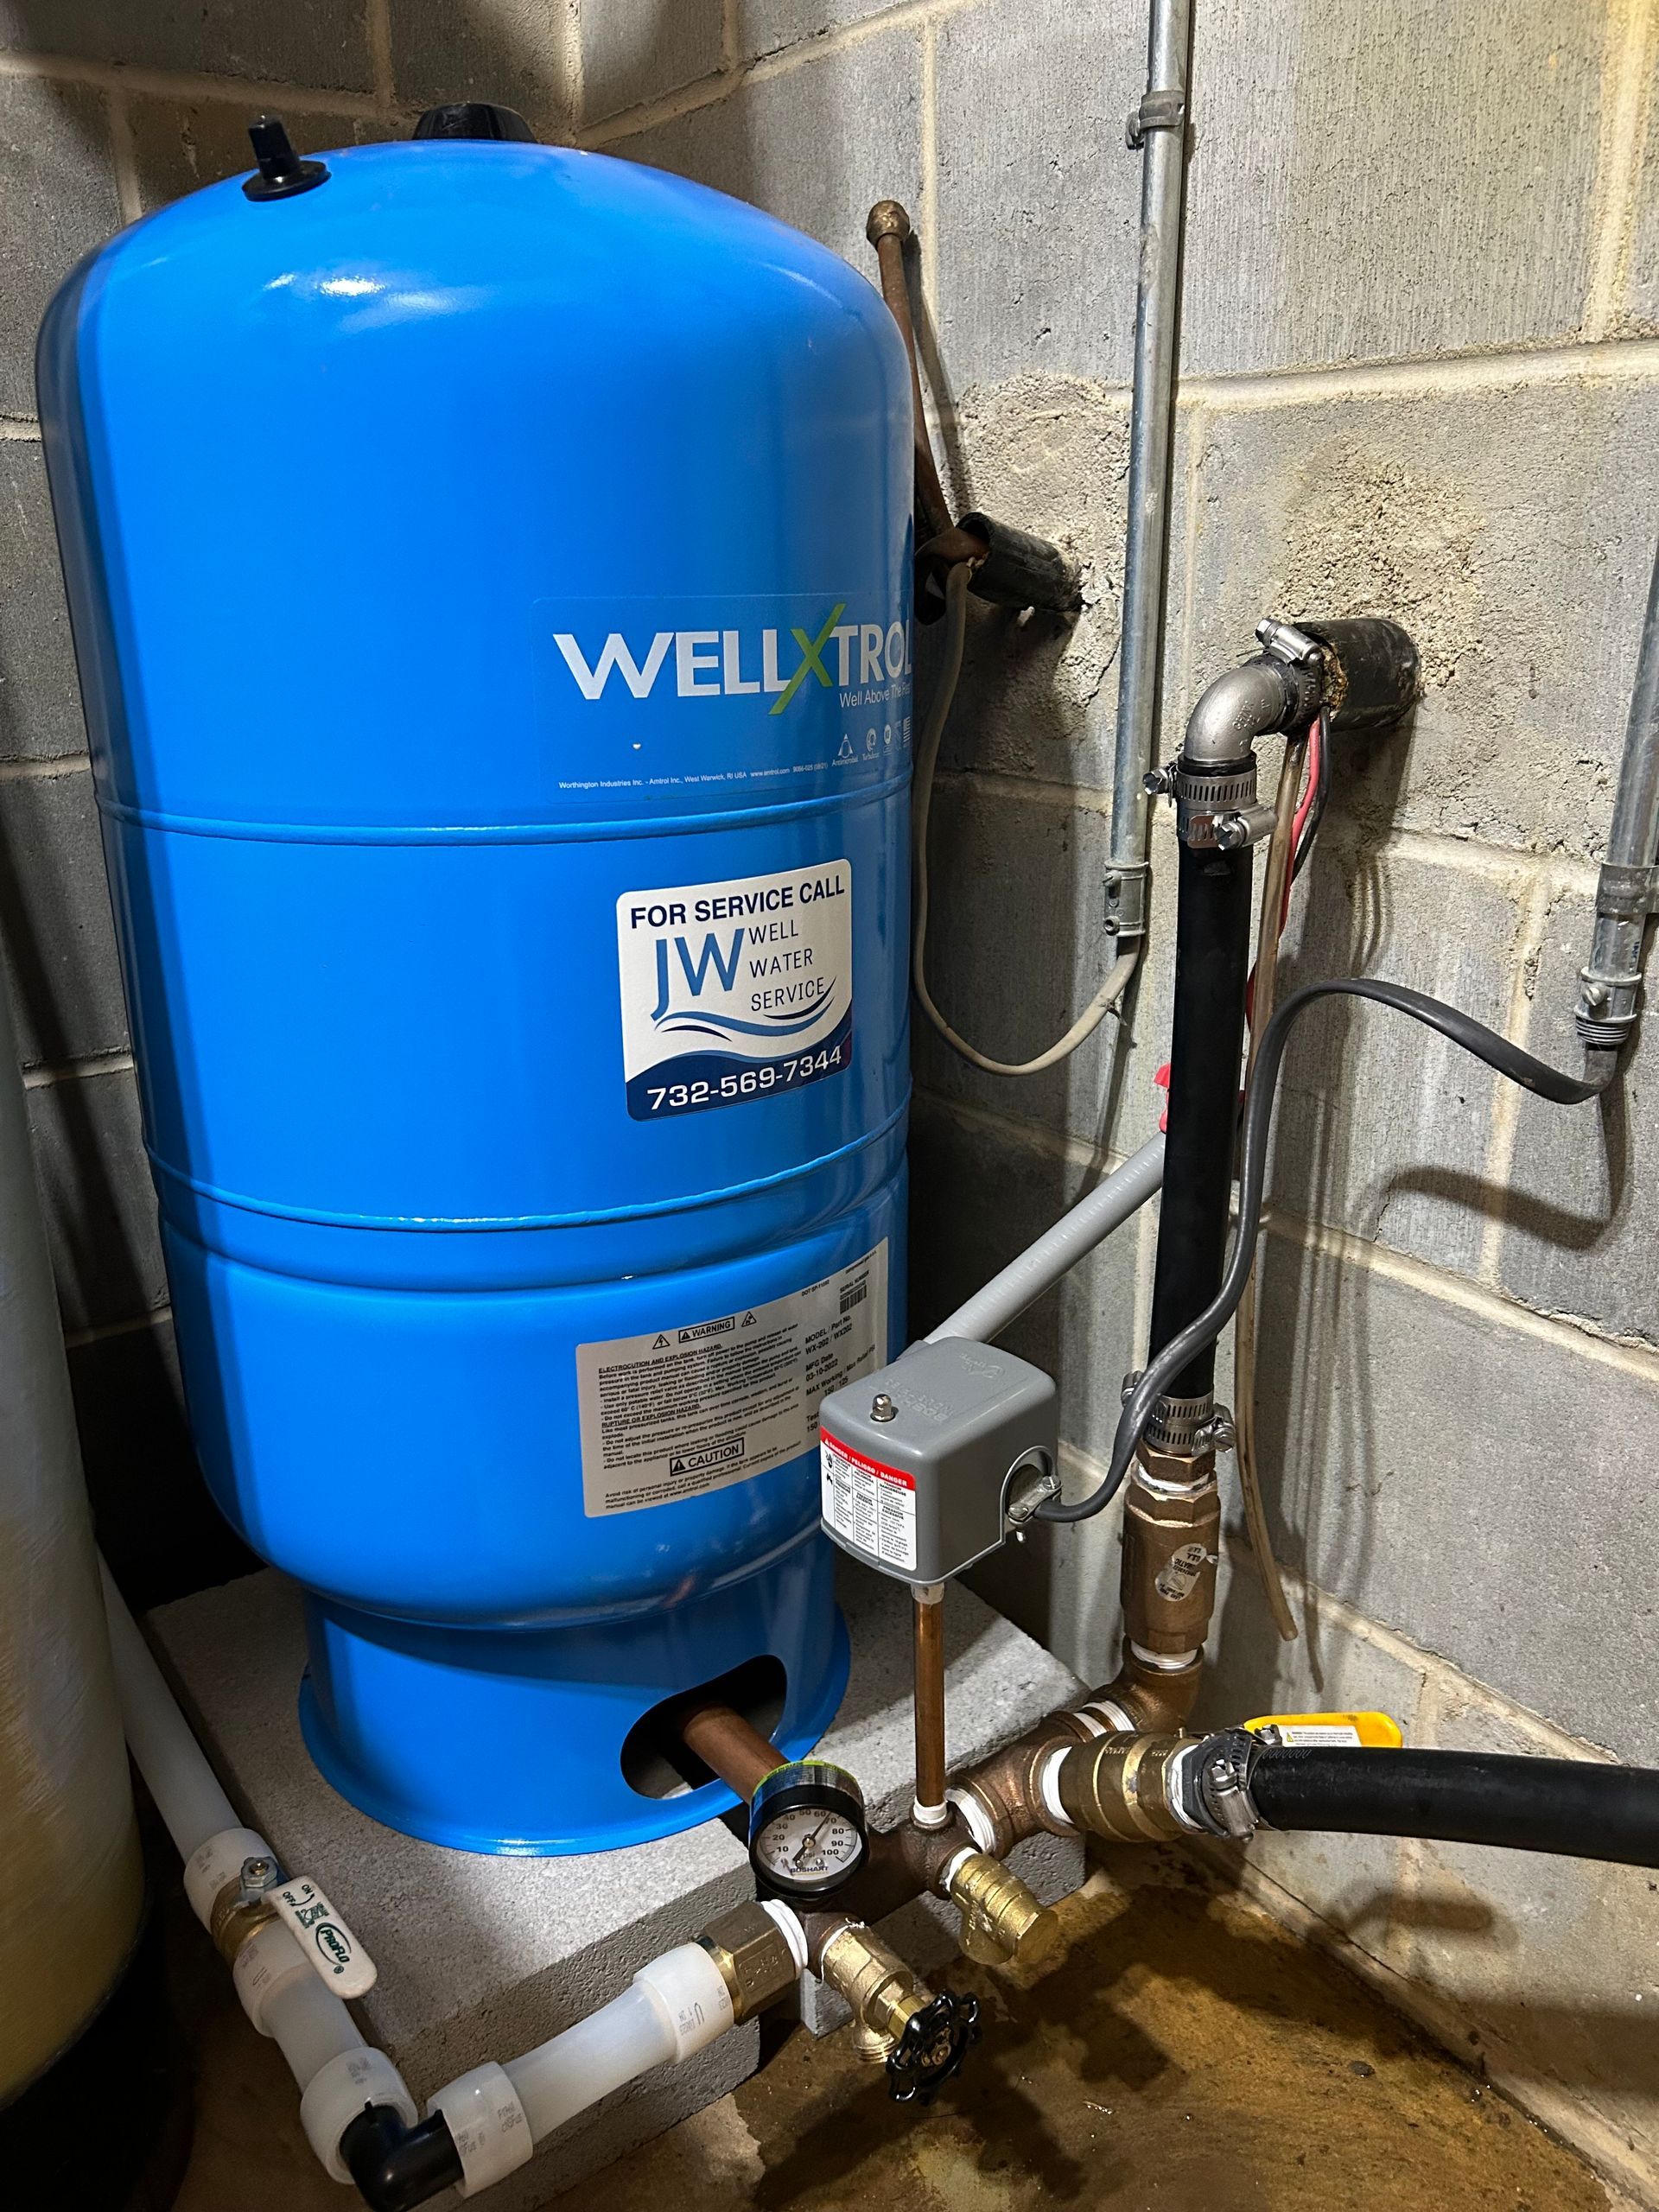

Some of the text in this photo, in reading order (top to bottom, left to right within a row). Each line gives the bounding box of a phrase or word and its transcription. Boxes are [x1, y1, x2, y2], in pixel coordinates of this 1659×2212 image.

[839, 690, 862, 709] Well
[864, 689, 890, 704] Above
[558, 781, 599, 790] Worthington
[734, 771, 747, 779] USA
[750, 768, 791, 778] www.amtrol.com
[631, 875, 845, 929] FOR SERVICE CALL
[748, 919, 798, 945] WELL
[651, 928, 745, 1022] JW
[749, 948, 813, 978] WATER
[751, 976, 824, 1012] SERVICE
[647, 1046, 842, 1111] 732-569-7344
[691, 1320, 731, 1338] WARNING
[805, 1328, 827, 1344] MODEL
[831, 1319, 842, 1331] Part
[805, 1337, 830, 1355] WX-202
[834, 1323, 852, 1340] WX202
[599, 1361, 650, 1374] ELECTROCUTION
[664, 1350, 697, 1362] EXPLOSION
[639, 1363, 665, 1373] performed
[664, 1365, 686, 1375] pumping
[805, 1352, 834, 1372] MFG Date
[805, 1358, 838, 1382] 03-10-2022
[806, 1382, 820, 1395] MAX
[821, 1371, 842, 1388] Working
[601, 1419, 630, 1427] RUPTURE
[642, 1409, 675, 1421] EXPLOSION
[688, 1444, 739, 1467] CAUTION
[851, 1456, 875, 1474] PELIGRO
[880, 1471, 907, 1486] DANGER
[282, 1891, 296, 1906] OFF
[302, 1885, 313, 1894] ON
[320, 1929, 350, 1962] PROFLO
